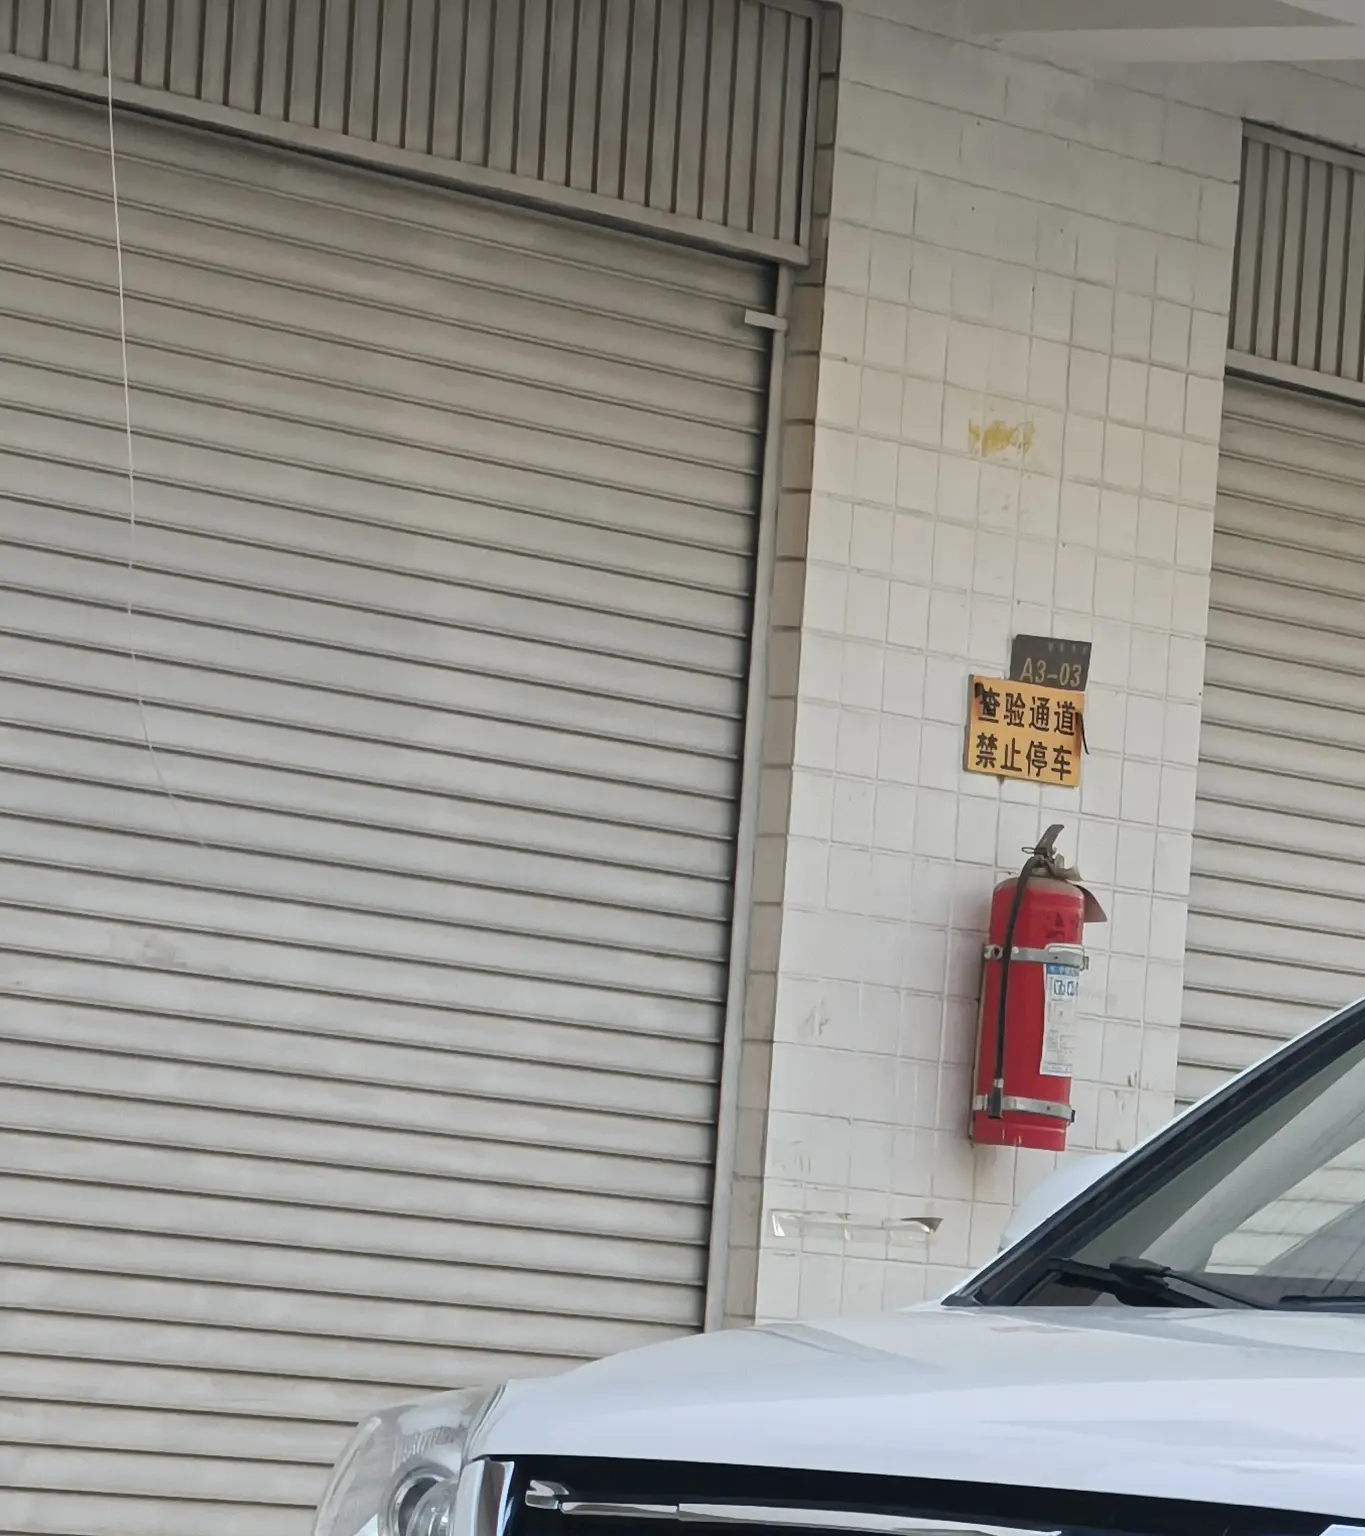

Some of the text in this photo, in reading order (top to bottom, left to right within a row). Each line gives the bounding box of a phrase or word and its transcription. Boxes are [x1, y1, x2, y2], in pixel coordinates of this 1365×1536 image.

[1019, 657, 1082, 688] A3-03
[977, 686, 1076, 736] 查验通道
[975, 732, 1073, 781] 禁止停车
